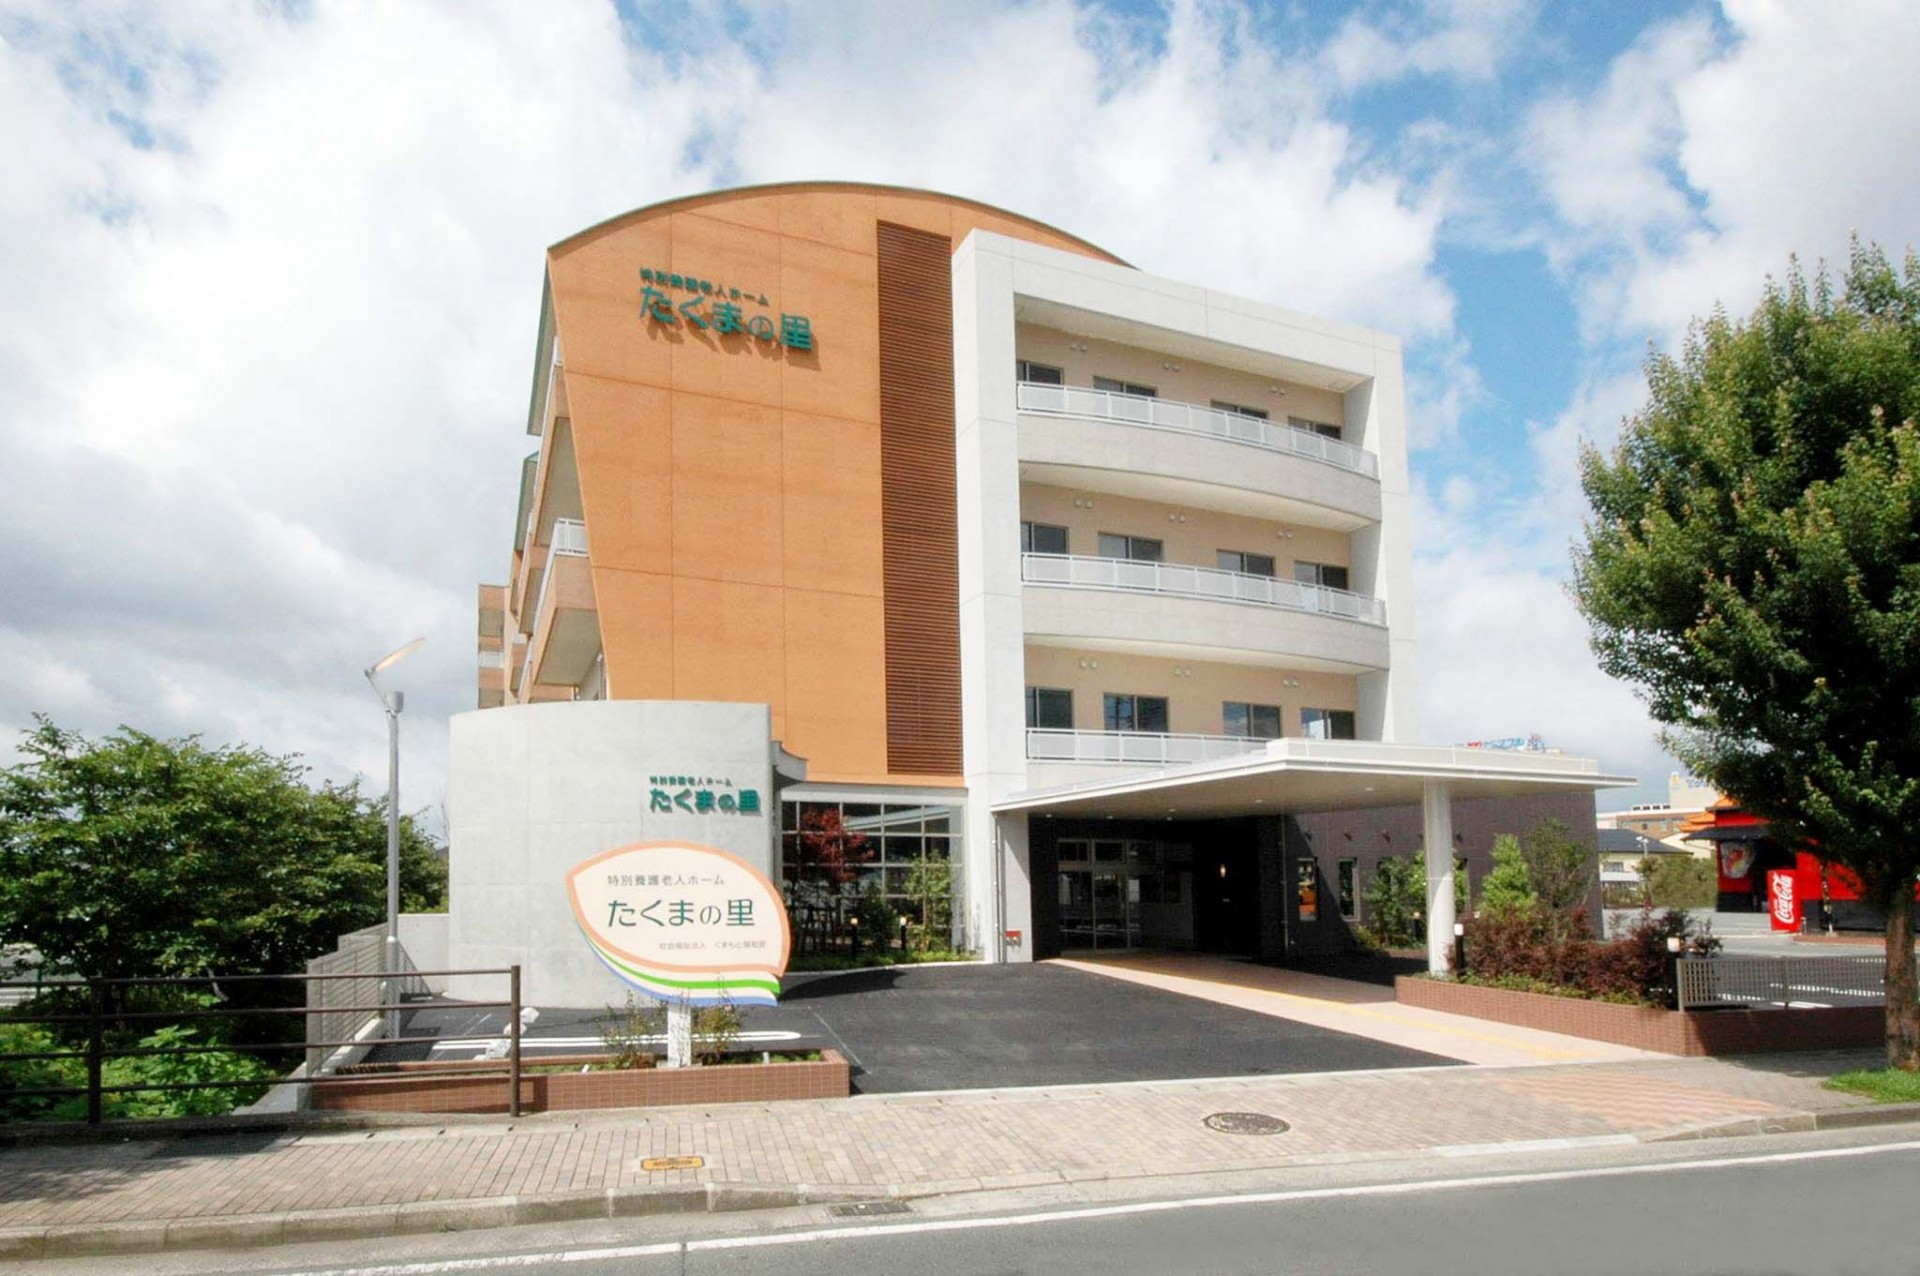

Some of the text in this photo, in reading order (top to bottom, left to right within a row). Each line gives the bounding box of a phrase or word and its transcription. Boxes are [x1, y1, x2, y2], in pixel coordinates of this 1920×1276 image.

[639, 285, 813, 351] たくまの里
[649, 787, 762, 814] たくまの里
[607, 874, 725, 887] 特別養護老人ホーム
[607, 898, 755, 928] たくまの里
